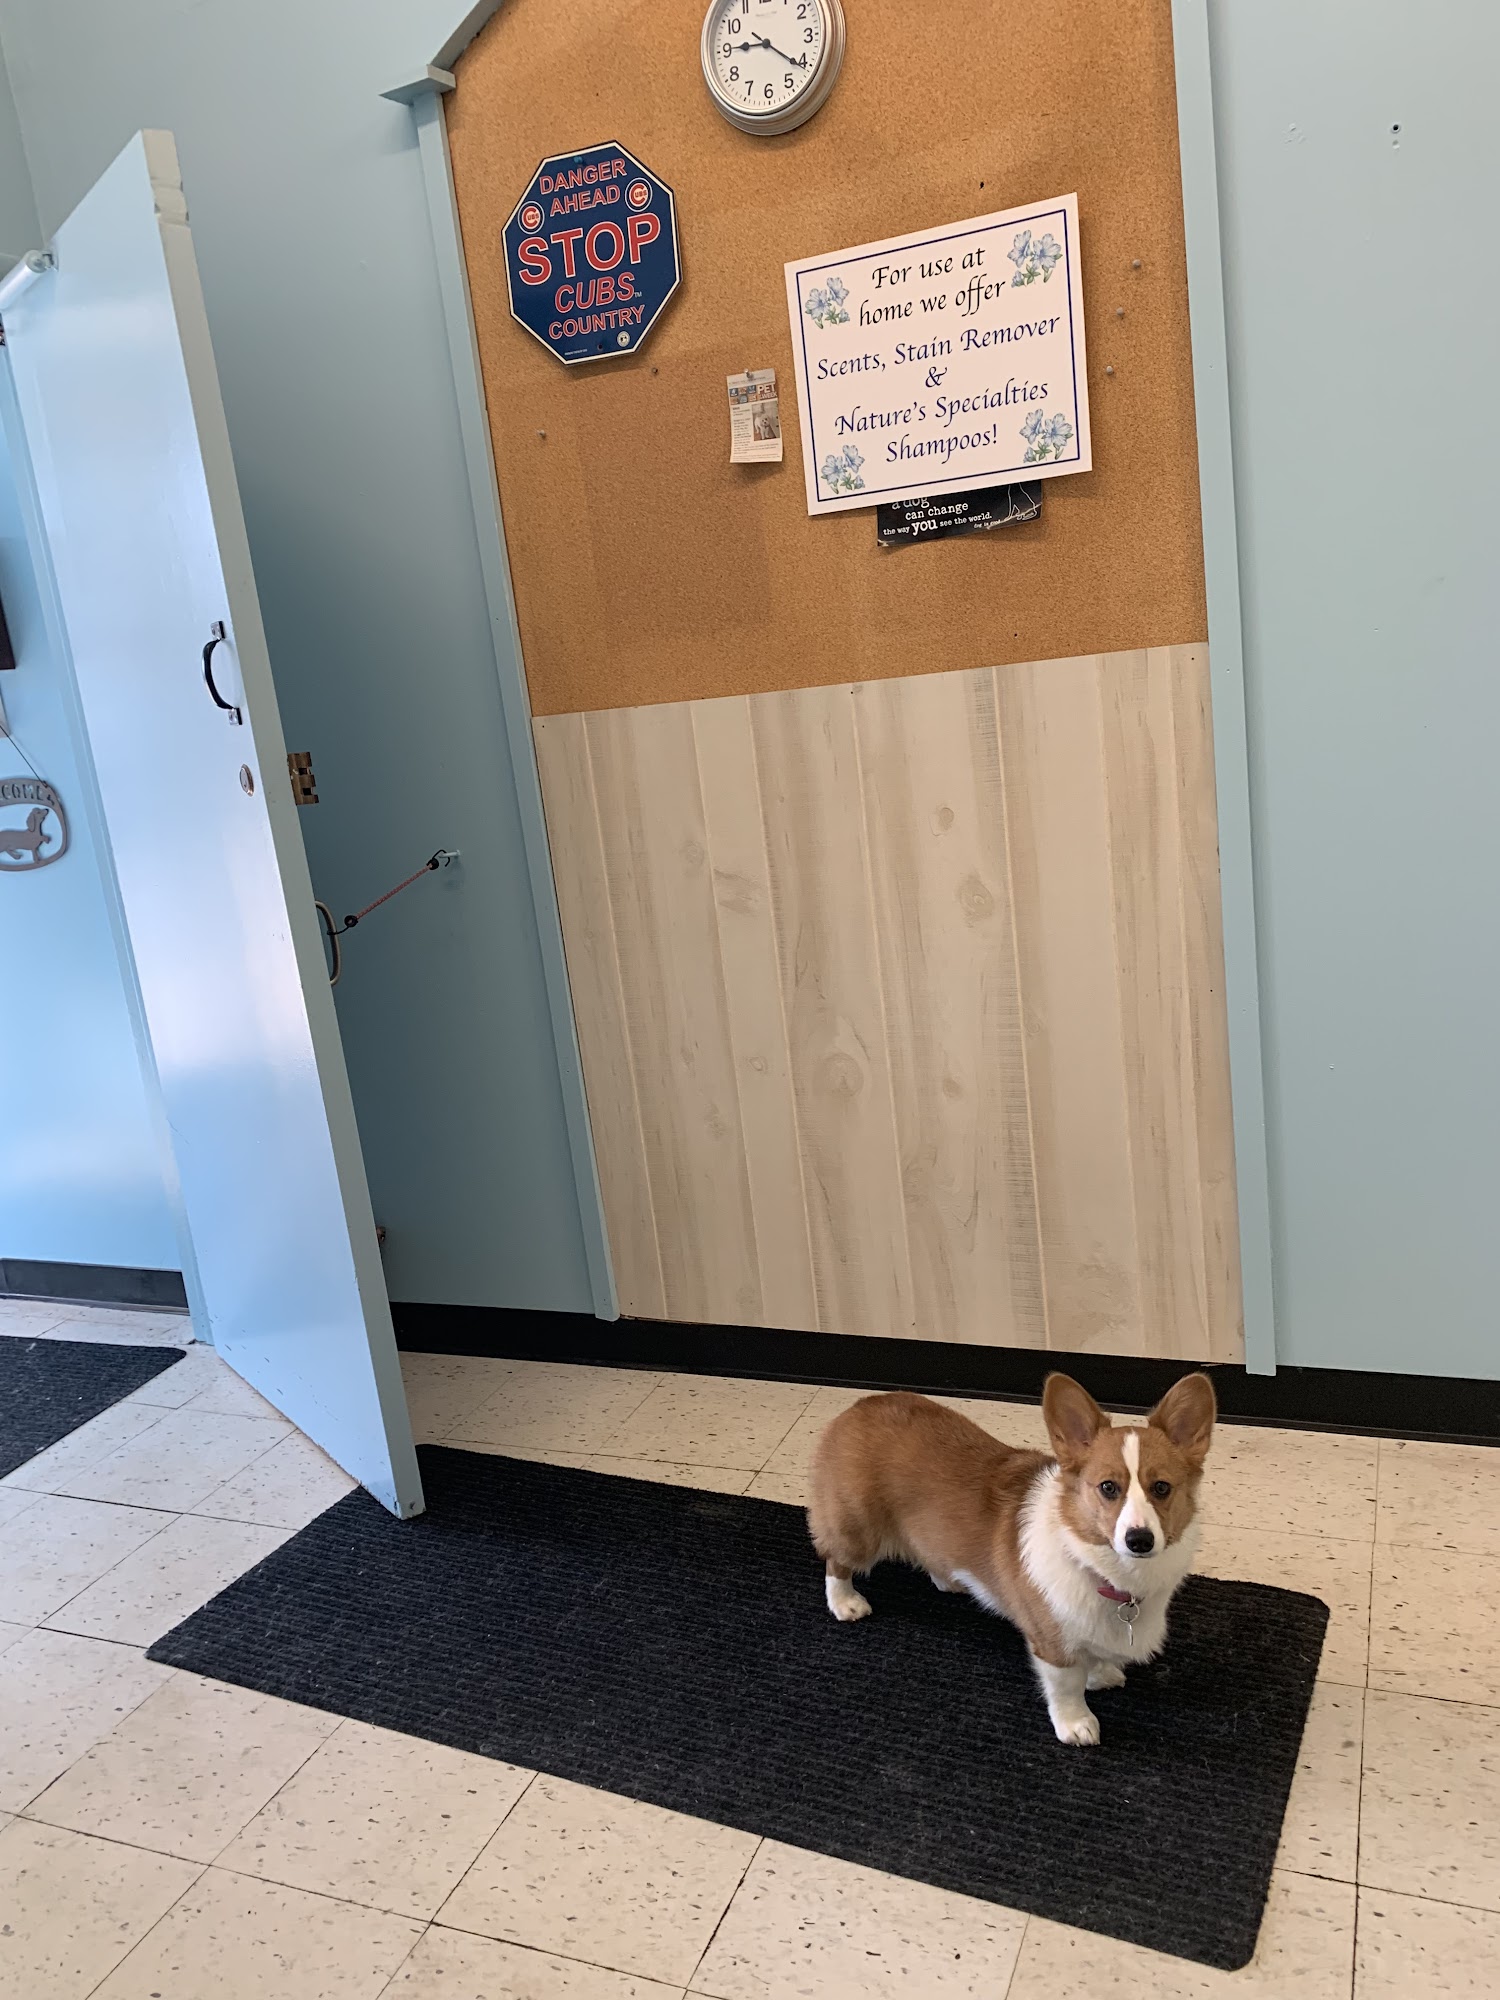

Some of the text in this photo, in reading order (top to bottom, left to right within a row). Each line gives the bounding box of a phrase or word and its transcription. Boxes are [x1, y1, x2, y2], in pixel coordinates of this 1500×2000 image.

[797, 4, 806, 20] 2
[727, 18, 741, 34] 10
[803, 27, 813, 43] 3
[722, 43, 732, 58] 9
[798, 53, 808, 69] 4
[729, 66, 739, 82] 8
[784, 73, 794, 89] 5
[744, 80, 754, 96] 7
[764, 83, 773, 98] 6
[539, 158, 627, 194] DANGER
[550, 184, 620, 216] AHEAD
[518, 213, 661, 286] STOP
[872, 247, 985, 289] For use at
[555, 272, 636, 313] CUBS
[859, 273, 1006, 326] home we offer
[548, 305, 645, 339] COUNTRY
[817, 316, 1060, 380] Scents, Stain Remover
[925, 366, 948, 388] &
[757, 383, 775, 395] PET
[834, 377, 1049, 436] Nature's Specialties
[886, 423, 998, 464] Shampoos!
[905, 502, 969, 520] can change
[882, 511, 992, 536] the way you see the world.
[1, 783, 44, 801] COME
